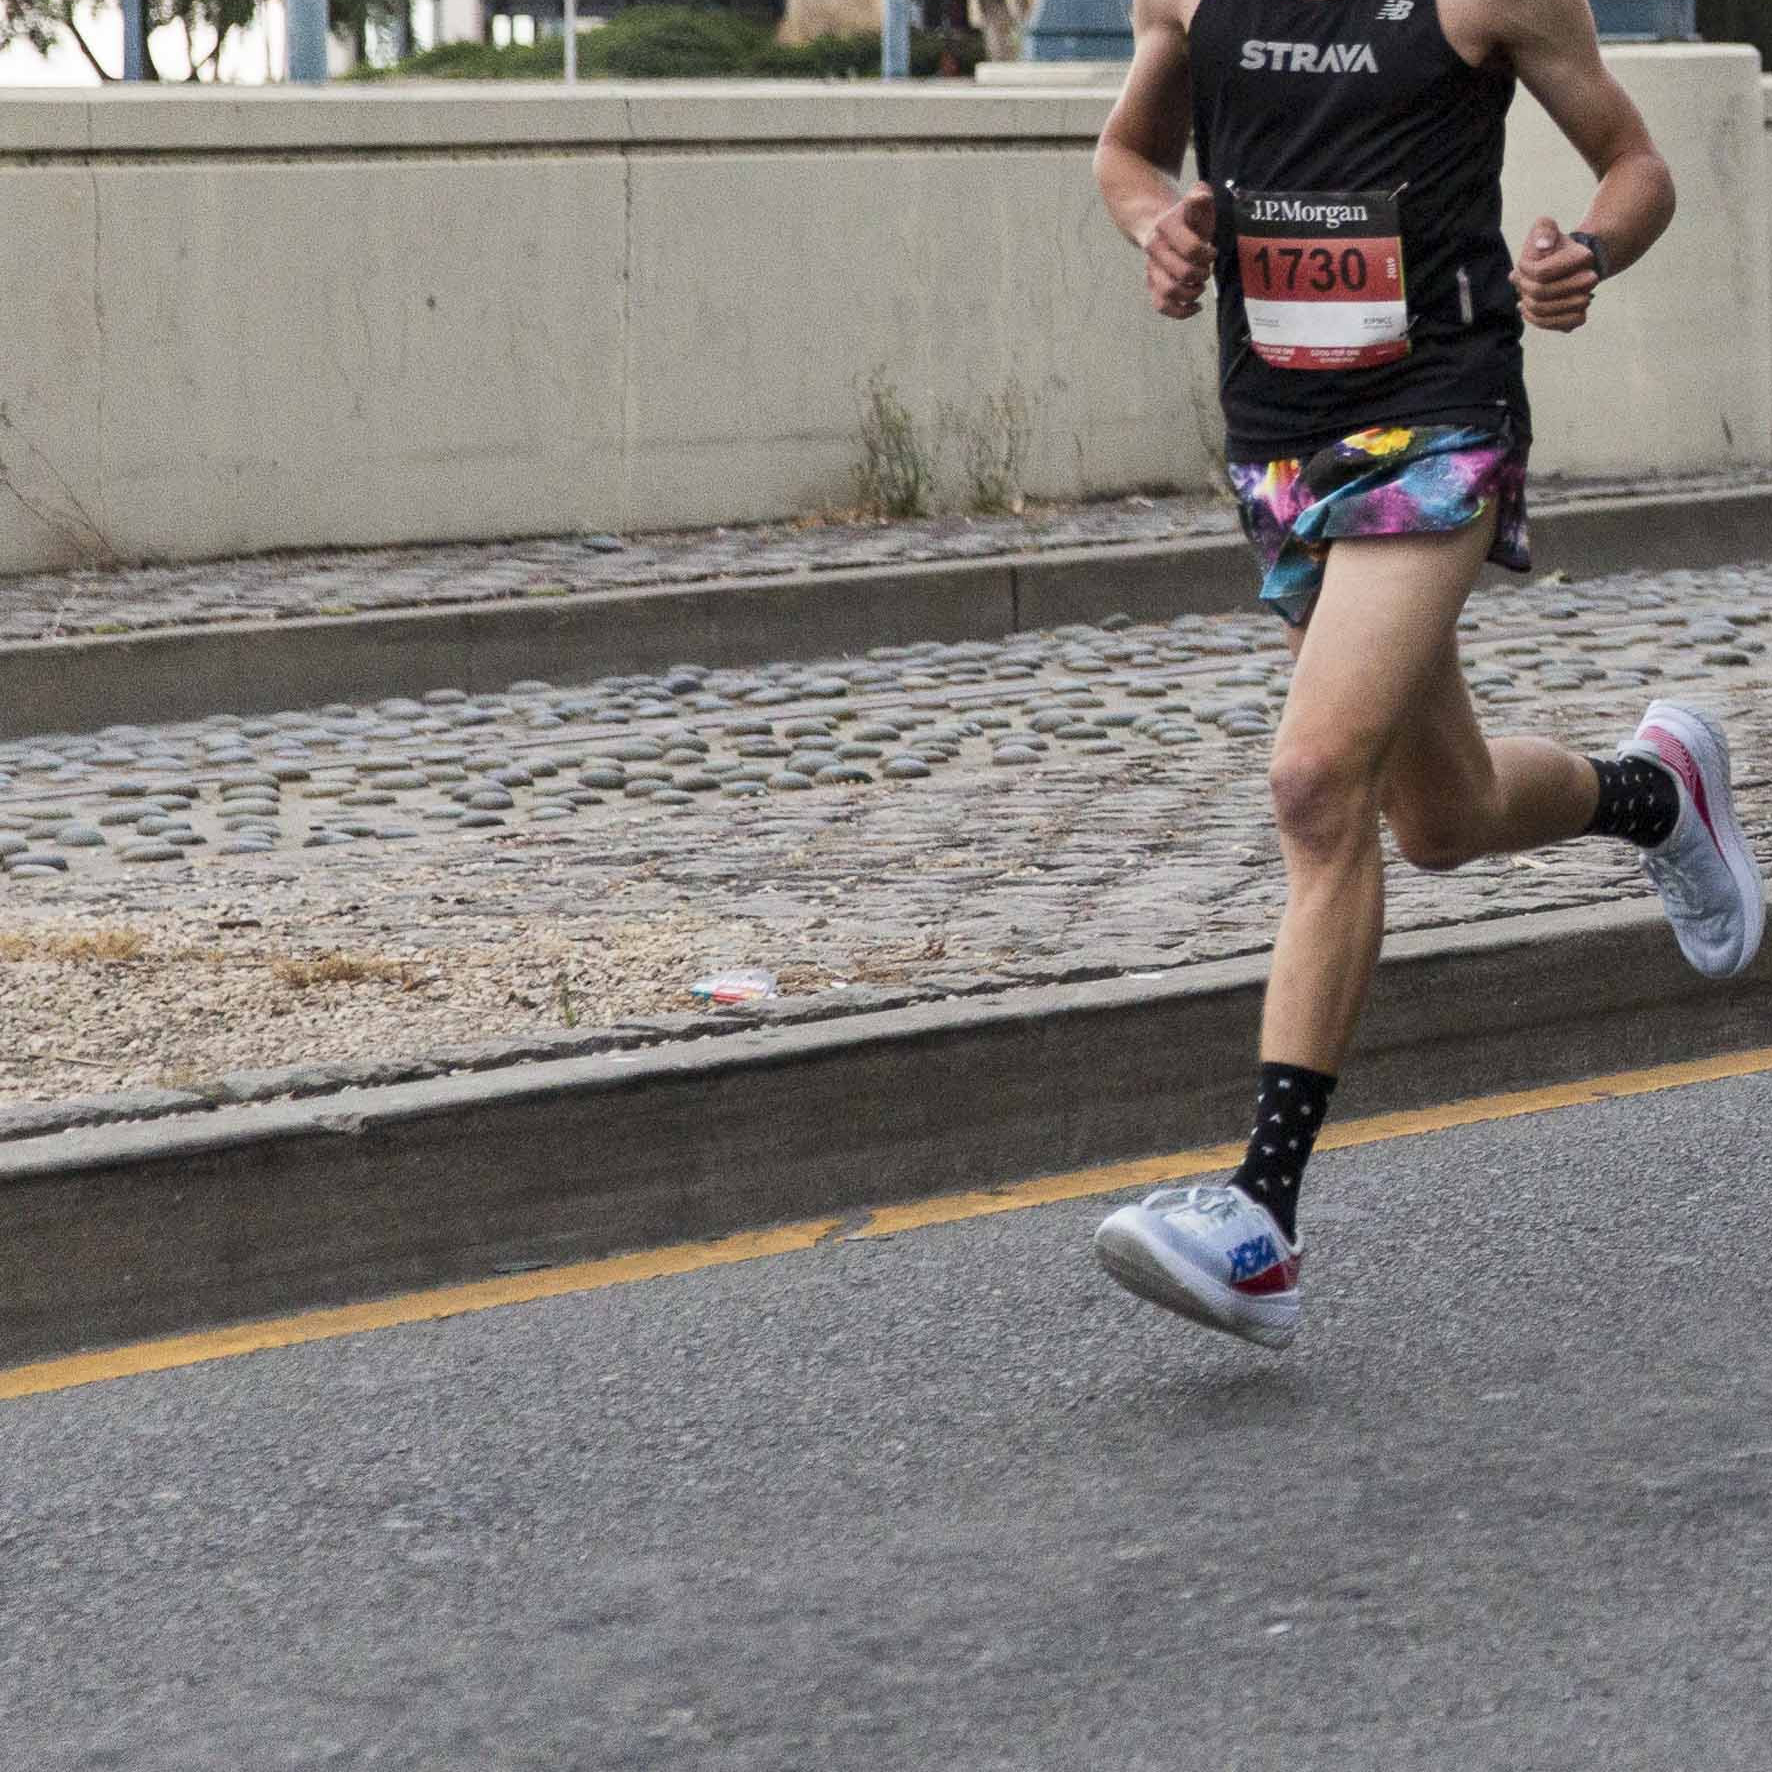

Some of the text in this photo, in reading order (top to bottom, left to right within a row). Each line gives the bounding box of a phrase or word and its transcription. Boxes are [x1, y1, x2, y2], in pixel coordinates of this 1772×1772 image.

[1239, 39, 1379, 74] STRAVA
[1250, 200, 1369, 229] J.P.Morgan
[1253, 246, 1368, 293] 1730
